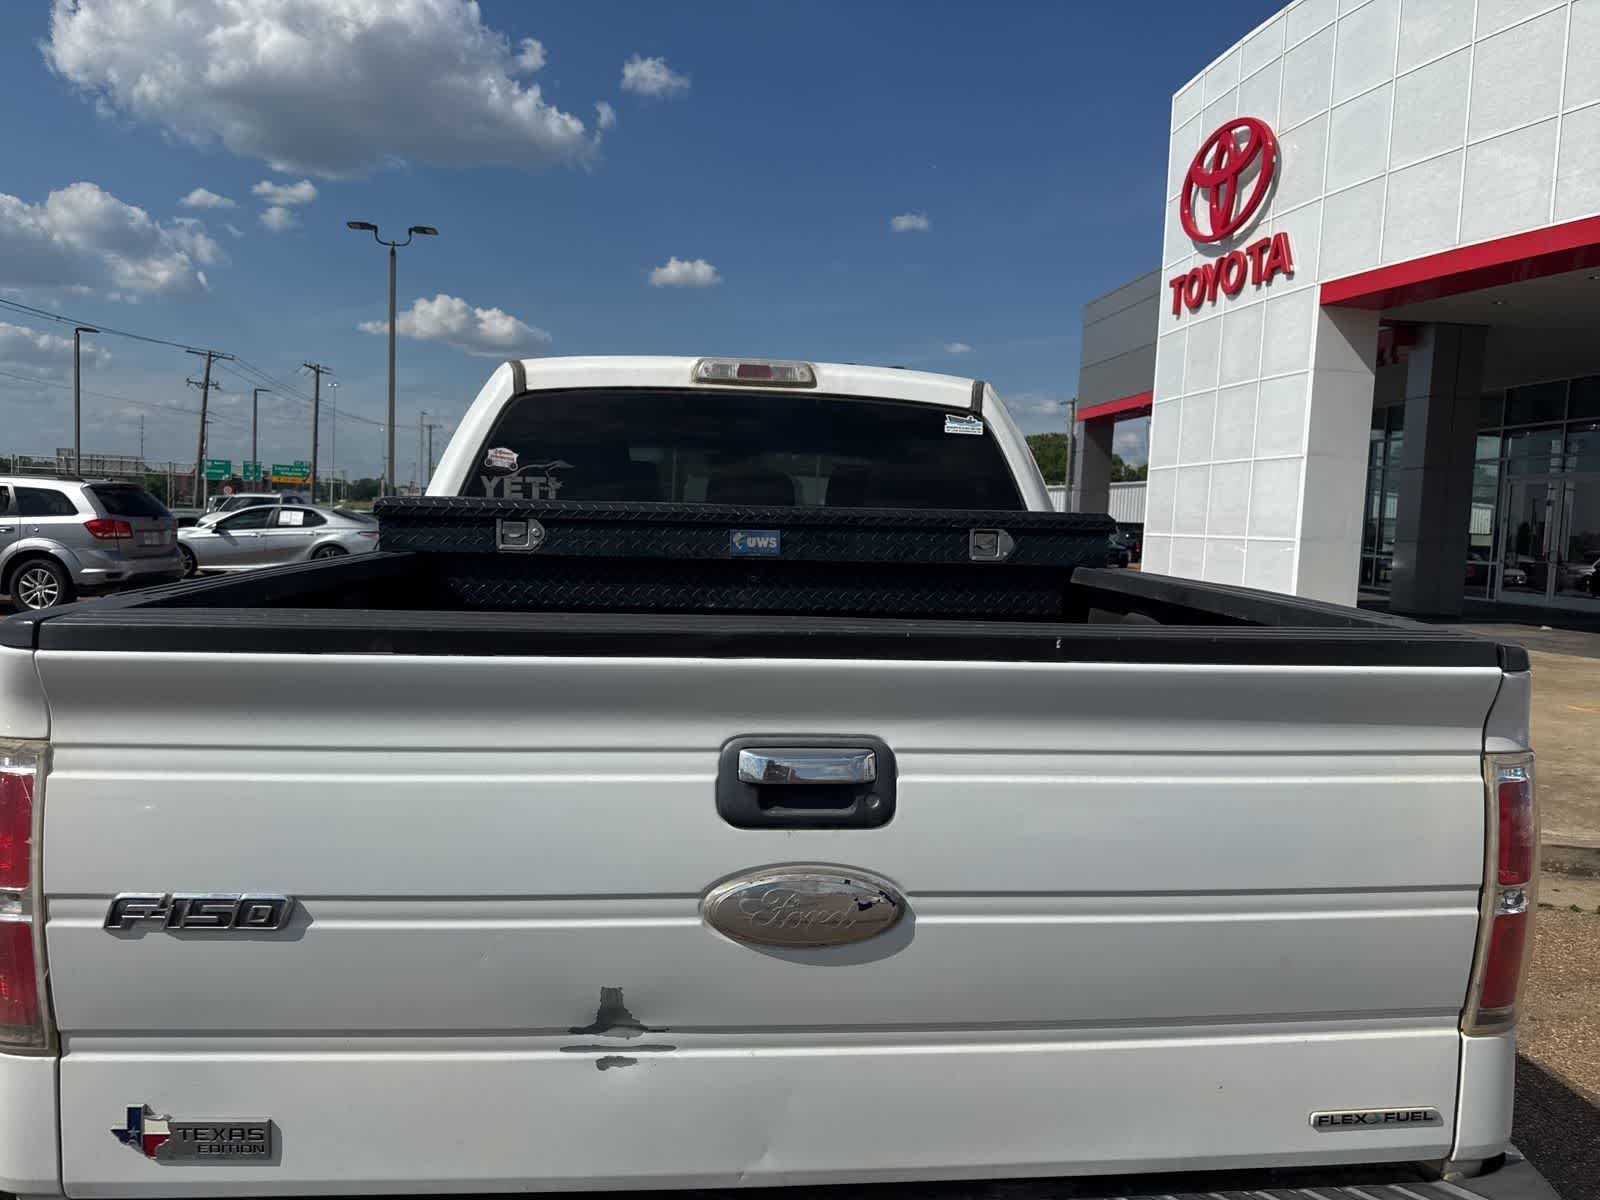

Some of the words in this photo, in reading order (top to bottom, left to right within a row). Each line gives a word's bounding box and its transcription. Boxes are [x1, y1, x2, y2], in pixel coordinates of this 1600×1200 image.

[1169, 232, 1294, 316] TOYOTA
[480, 475, 557, 499] YETI
[746, 536, 777, 548] UWS
[104, 892, 291, 930] F-150
[739, 887, 858, 929] Ford
[1318, 1113, 1369, 1126] FLEX
[1383, 1110, 1434, 1122] FUEL
[176, 1127, 265, 1141] TEXAS
[197, 1143, 265, 1154] EDITION
